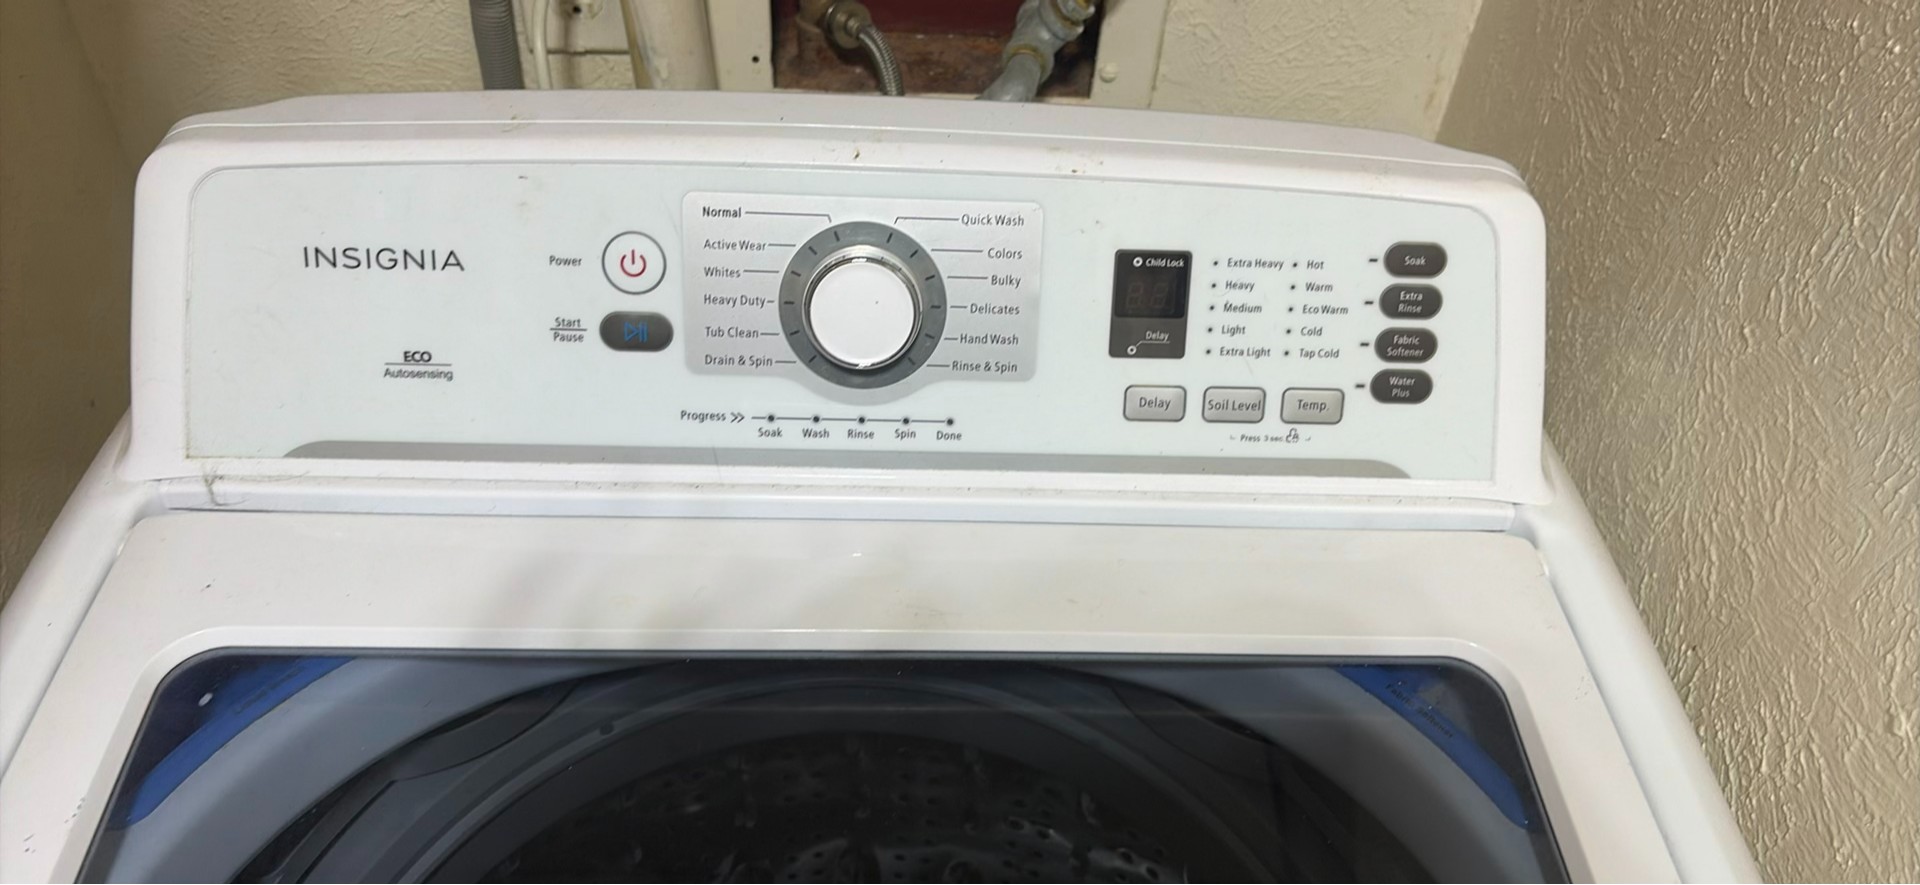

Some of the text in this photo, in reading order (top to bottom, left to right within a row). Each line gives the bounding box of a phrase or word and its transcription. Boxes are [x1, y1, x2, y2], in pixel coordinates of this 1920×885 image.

[702, 207, 742, 218] Normal
[961, 214, 1024, 227] Quick Wash
[704, 239, 767, 251] Active Wear
[303, 246, 465, 272] INSIGNIA
[987, 248, 1023, 260] Colors
[549, 255, 582, 267] Power
[1145, 257, 1185, 268] Child Lock
[1227, 258, 1284, 271] Extra Heavy
[1307, 260, 1324, 270] Hot
[1404, 256, 1426, 266] Soak
[704, 267, 741, 278] Whites
[991, 275, 1021, 289] Bulky
[1225, 281, 1255, 293] Heavy
[1305, 282, 1333, 292] Warm
[704, 295, 766, 308] Heavy Duty
[1400, 291, 1423, 302] Extra
[970, 303, 1020, 315] Delicates
[1223, 302, 1262, 314] Medium
[1302, 305, 1349, 315] Eco Warm
[1398, 303, 1422, 314] Rinse
[554, 317, 581, 328] Start
[705, 327, 759, 338] Tub Clean
[1221, 325, 1246, 336] Light
[1301, 326, 1323, 337] Cold
[553, 332, 584, 343] Pause
[960, 333, 1019, 345] Hand Wash
[1145, 331, 1169, 342] Delay
[1393, 335, 1420, 346] Fabric
[403, 351, 432, 363] ECO
[1220, 347, 1270, 358] Extra Light
[1300, 349, 1339, 360] Tap Cold
[1387, 347, 1423, 357] Softener
[705, 355, 773, 368] Drain & Spin
[952, 360, 1018, 374] Rinse & Spin
[383, 368, 453, 381] Autosensing
[1389, 376, 1415, 386] Water
[1392, 388, 1410, 398] Plus
[1139, 397, 1171, 411] Delay
[1208, 400, 1261, 412] Soil Level
[1297, 400, 1330, 413] Temp.
[680, 410, 727, 423] Progress
[758, 427, 783, 438] Soak
[802, 428, 830, 439] Wash
[847, 429, 874, 440] Rinse
[894, 429, 916, 441] Spin
[936, 430, 962, 441] Done
[1240, 434, 1261, 443] Press
